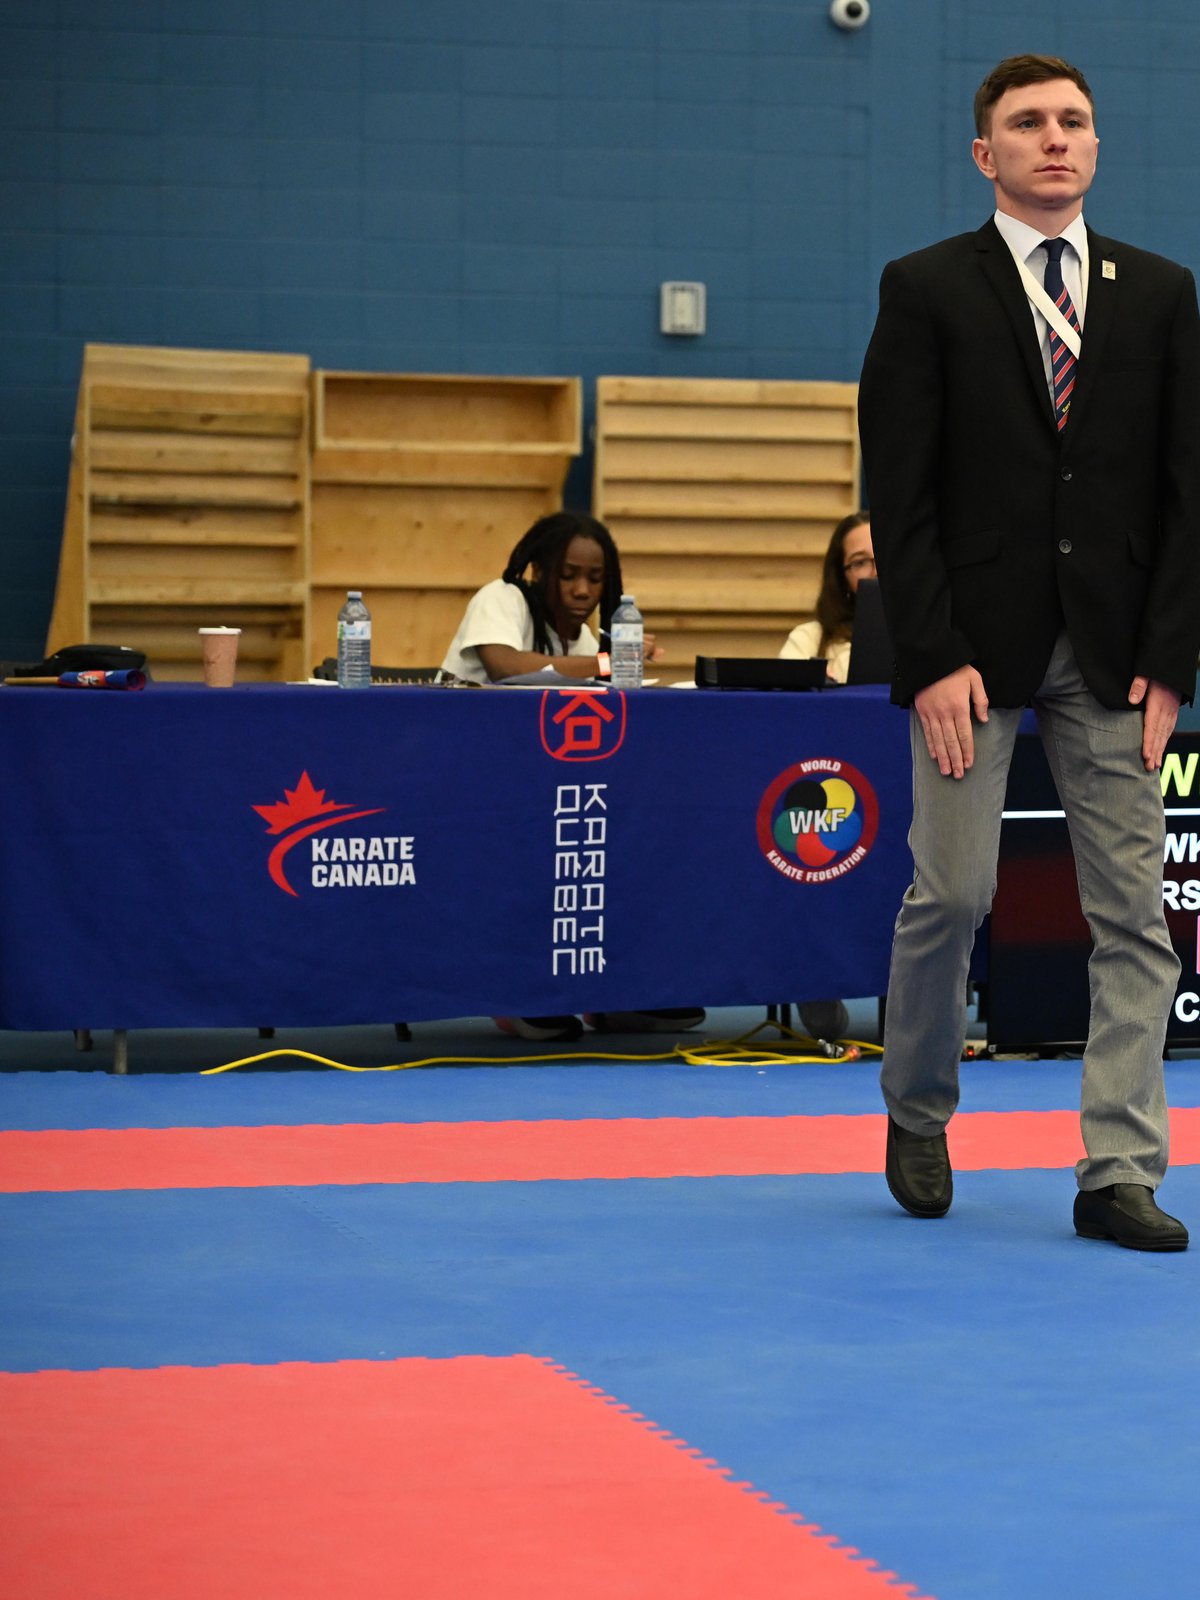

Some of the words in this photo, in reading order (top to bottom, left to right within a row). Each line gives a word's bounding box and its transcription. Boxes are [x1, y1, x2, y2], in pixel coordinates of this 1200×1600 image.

[800, 759, 841, 773] WORLD
[789, 808, 846, 834] WKF
[311, 836, 415, 862] KARATE
[311, 862, 417, 888] CANADA
[766, 849, 804, 881] KARATE
[806, 845, 867, 882] FEDERATION
[552, 785, 582, 976] QUÉBEC
[579, 783, 608, 975] KARATÉ
